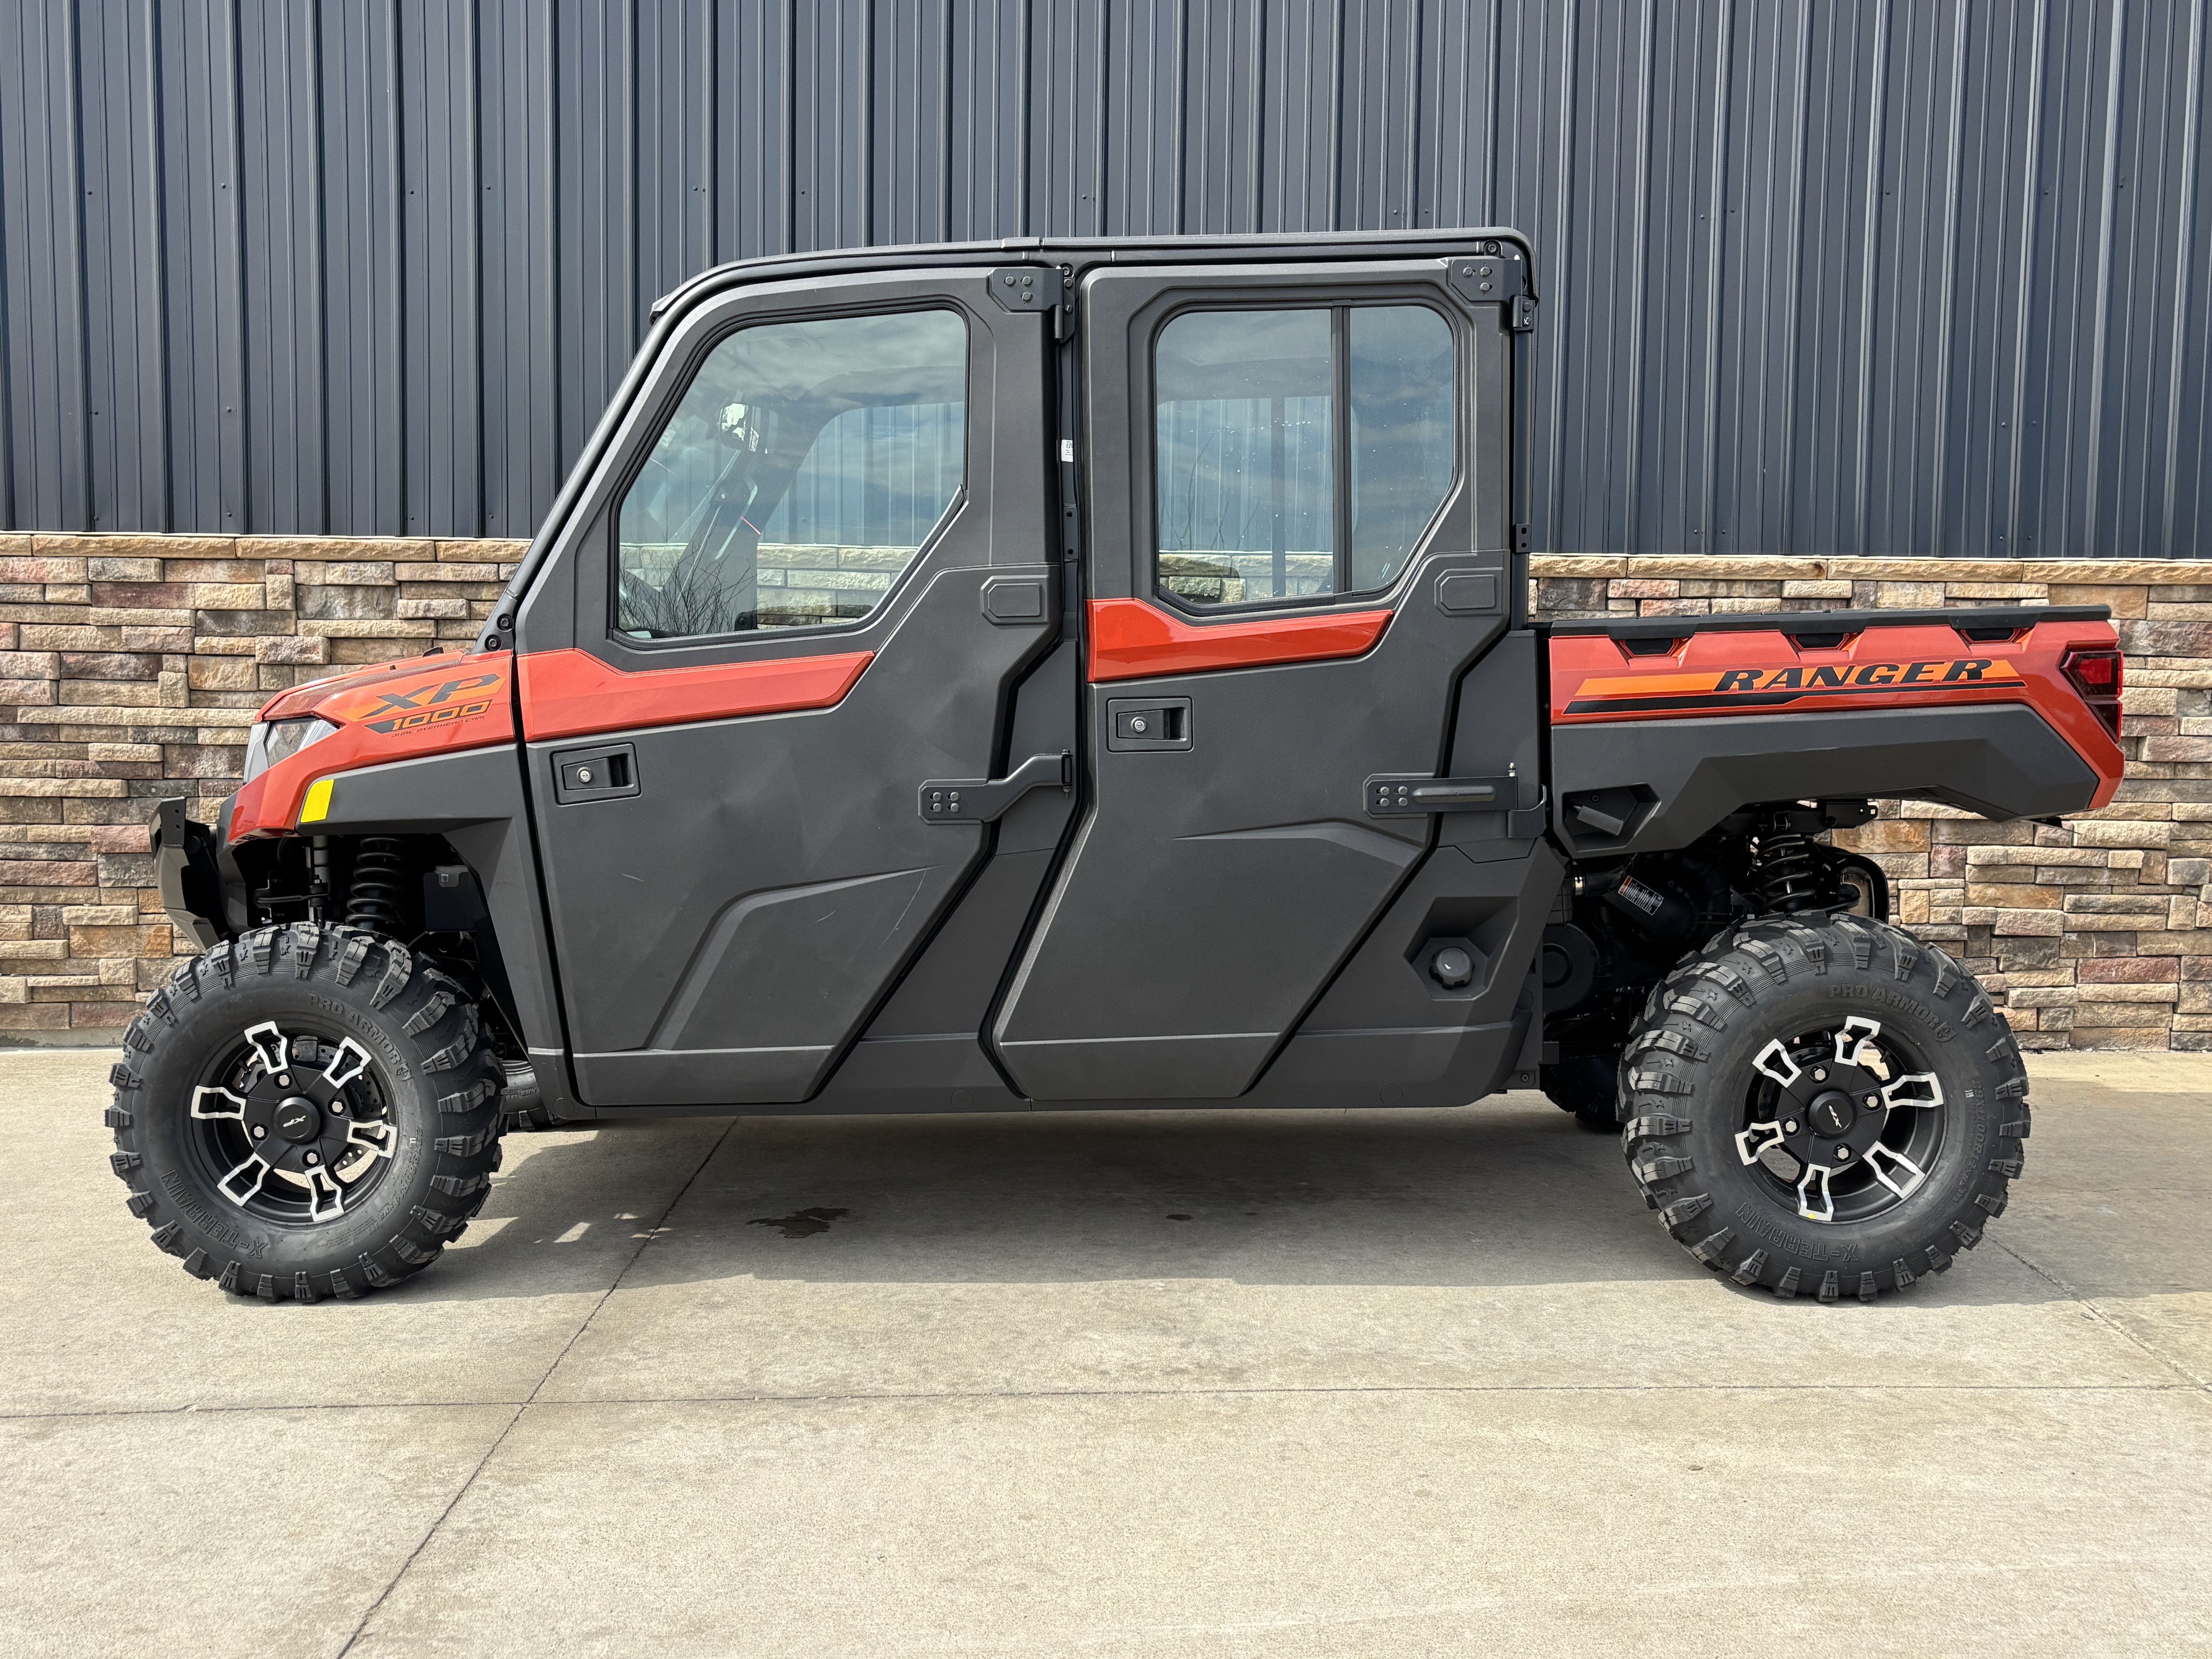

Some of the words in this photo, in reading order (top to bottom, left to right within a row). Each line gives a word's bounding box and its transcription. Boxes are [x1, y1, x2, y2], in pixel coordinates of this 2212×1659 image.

[359, 673, 500, 718] XP
[1713, 659, 1992, 692] RANGER
[391, 729, 414, 738] DUAL
[417, 719, 463, 732] OVERHEAD
[392, 701, 491, 730] 1000
[1829, 984, 1869, 998] PRO
[1872, 987, 1942, 1029] ARMOR
[311, 995, 344, 1015] PRO
[347, 1011, 401, 1065] ARMOR
[160, 1170, 269, 1259] X-TERRAIN
[1735, 1201, 1859, 1262] X-TERRAIN
